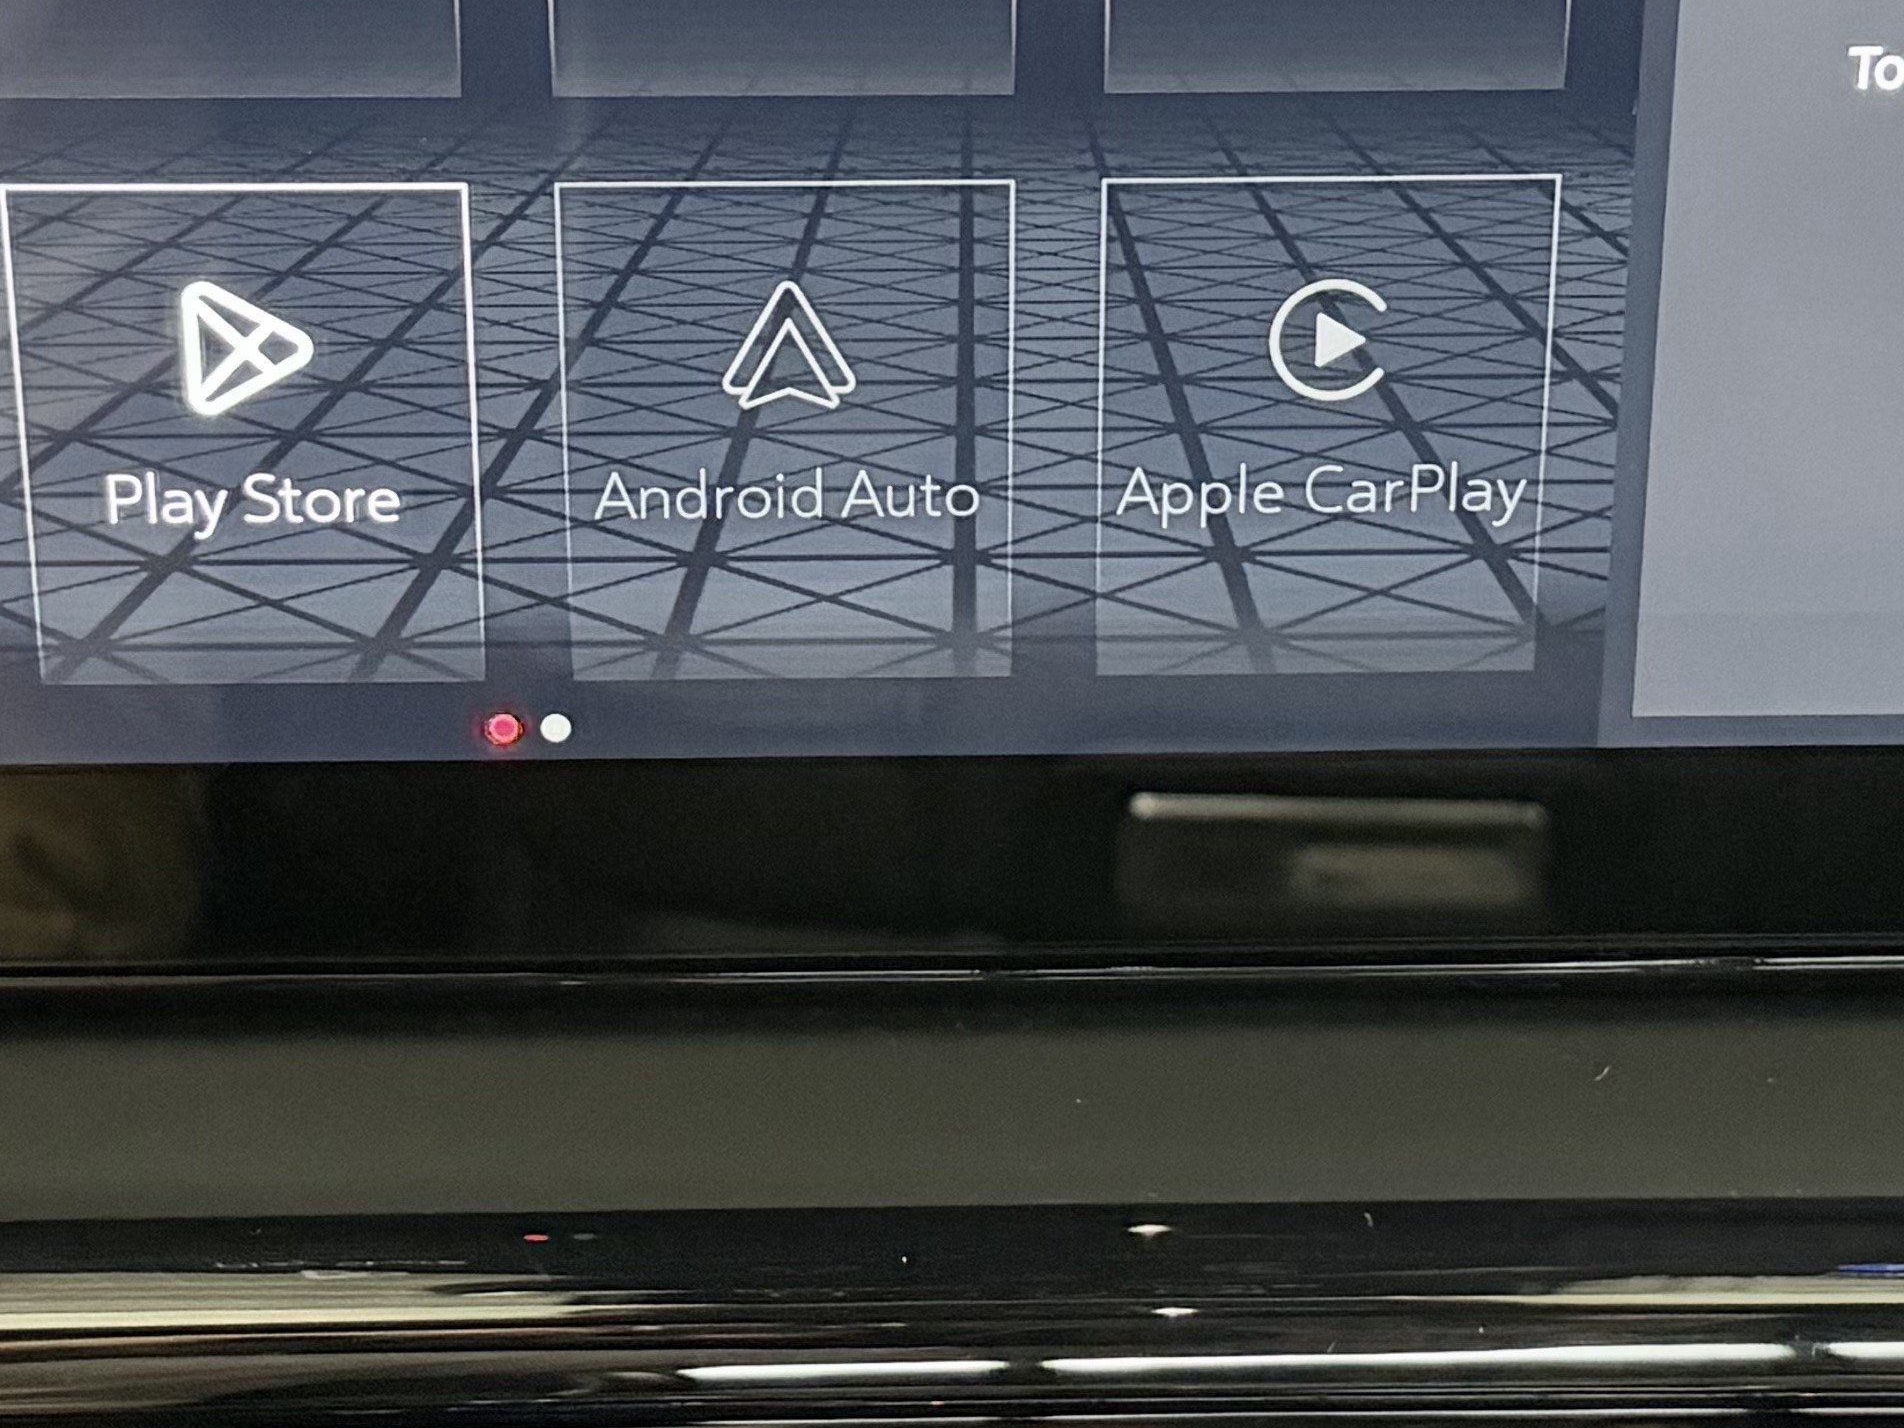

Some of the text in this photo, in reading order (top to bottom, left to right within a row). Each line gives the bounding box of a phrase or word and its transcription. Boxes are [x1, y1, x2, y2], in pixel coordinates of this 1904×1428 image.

[105, 472, 402, 541] Play Store
[592, 467, 981, 523] Android Auto
[1115, 460, 1529, 530] Apple CarPlay
